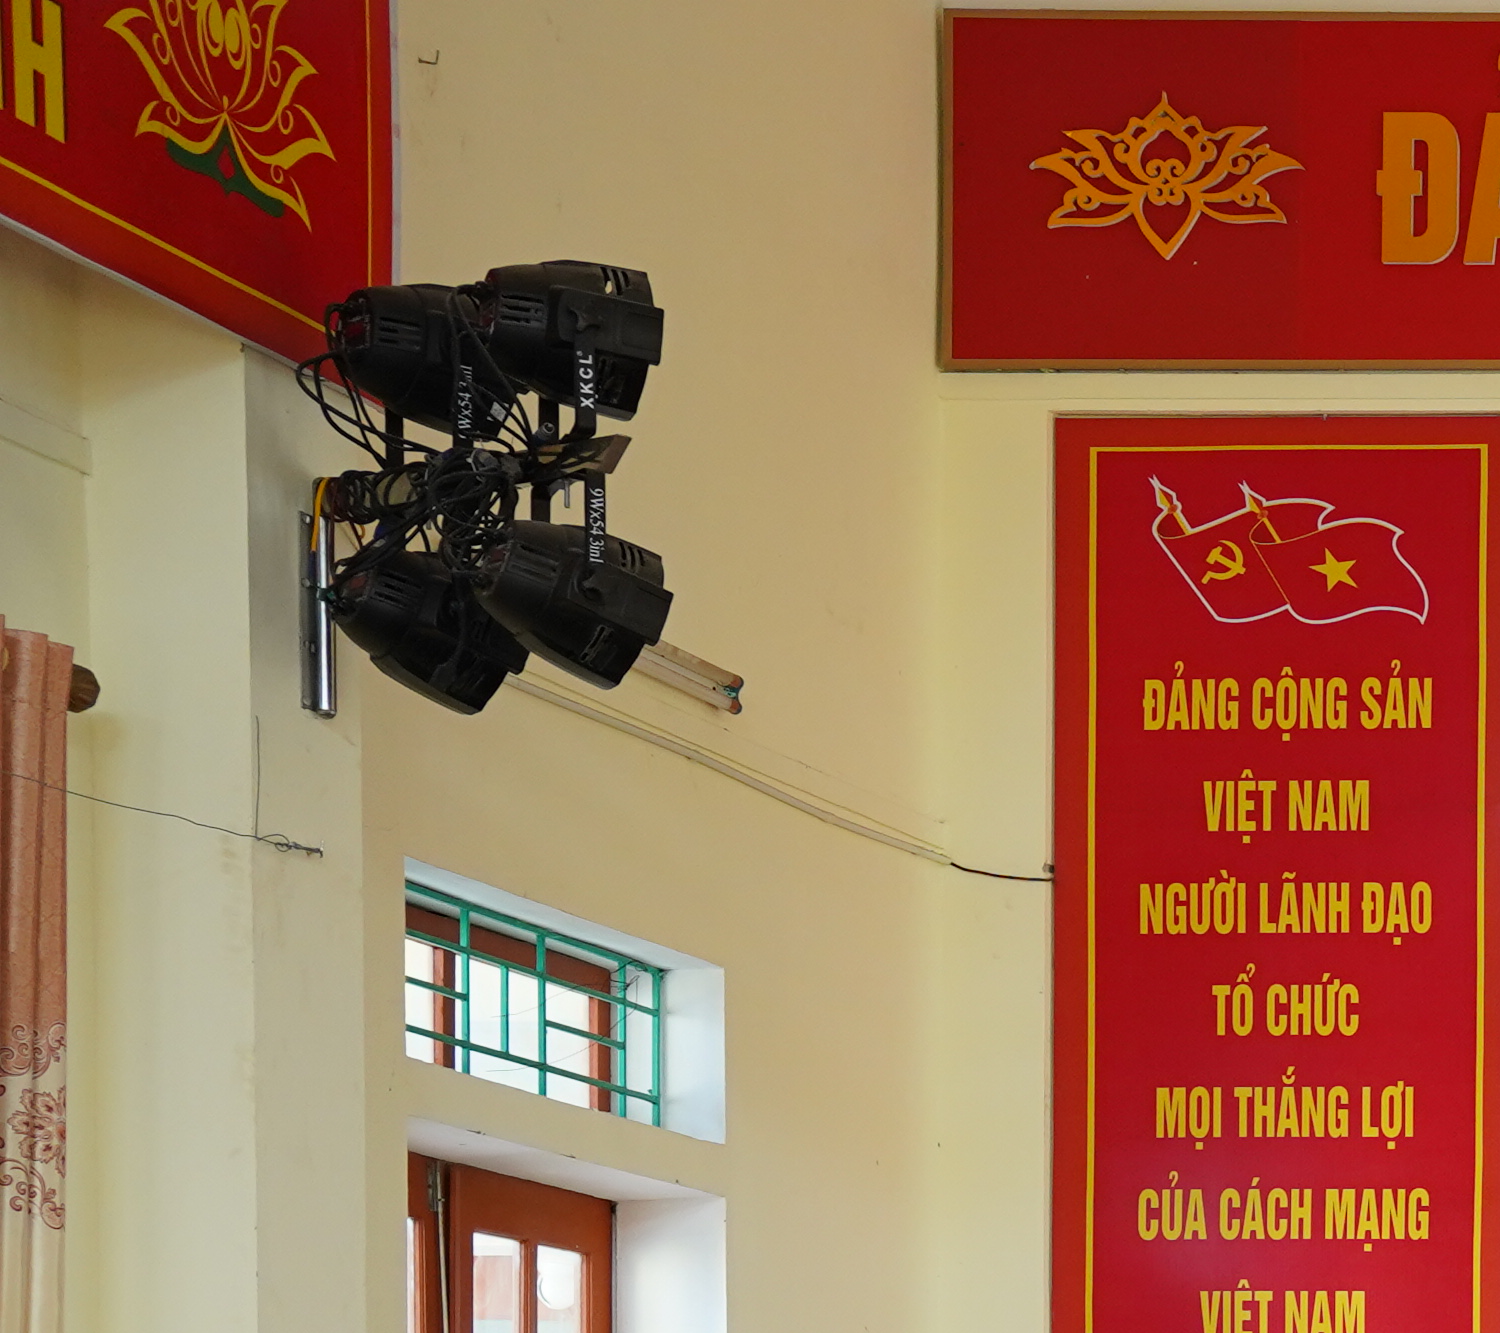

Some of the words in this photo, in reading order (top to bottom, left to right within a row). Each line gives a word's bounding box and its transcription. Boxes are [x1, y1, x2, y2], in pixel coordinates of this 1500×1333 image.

[1143, 661, 1239, 730] ĐẢNG
[1252, 667, 1347, 741] CỘNG
[1360, 660, 1432, 729] SẢN
[1204, 769, 1276, 843] VIỆT
[1289, 780, 1369, 831] NAM
[1140, 870, 1246, 934] NGƯỜI
[1260, 872, 1349, 933] LÃNH
[1361, 881, 1432, 945] ĐẠO
[1212, 963, 1255, 1036] TỔ
[1267, 979, 1359, 1036] CHỨC
[1156, 1086, 1221, 1150] MỌI
[1234, 1066, 1348, 1138] THẮNG
[1362, 1081, 1414, 1149] LỢI
[1138, 1171, 1207, 1240] CỦA
[1219, 1177, 1312, 1240] CÁCH
[1325, 1188, 1429, 1251] MẠNG
